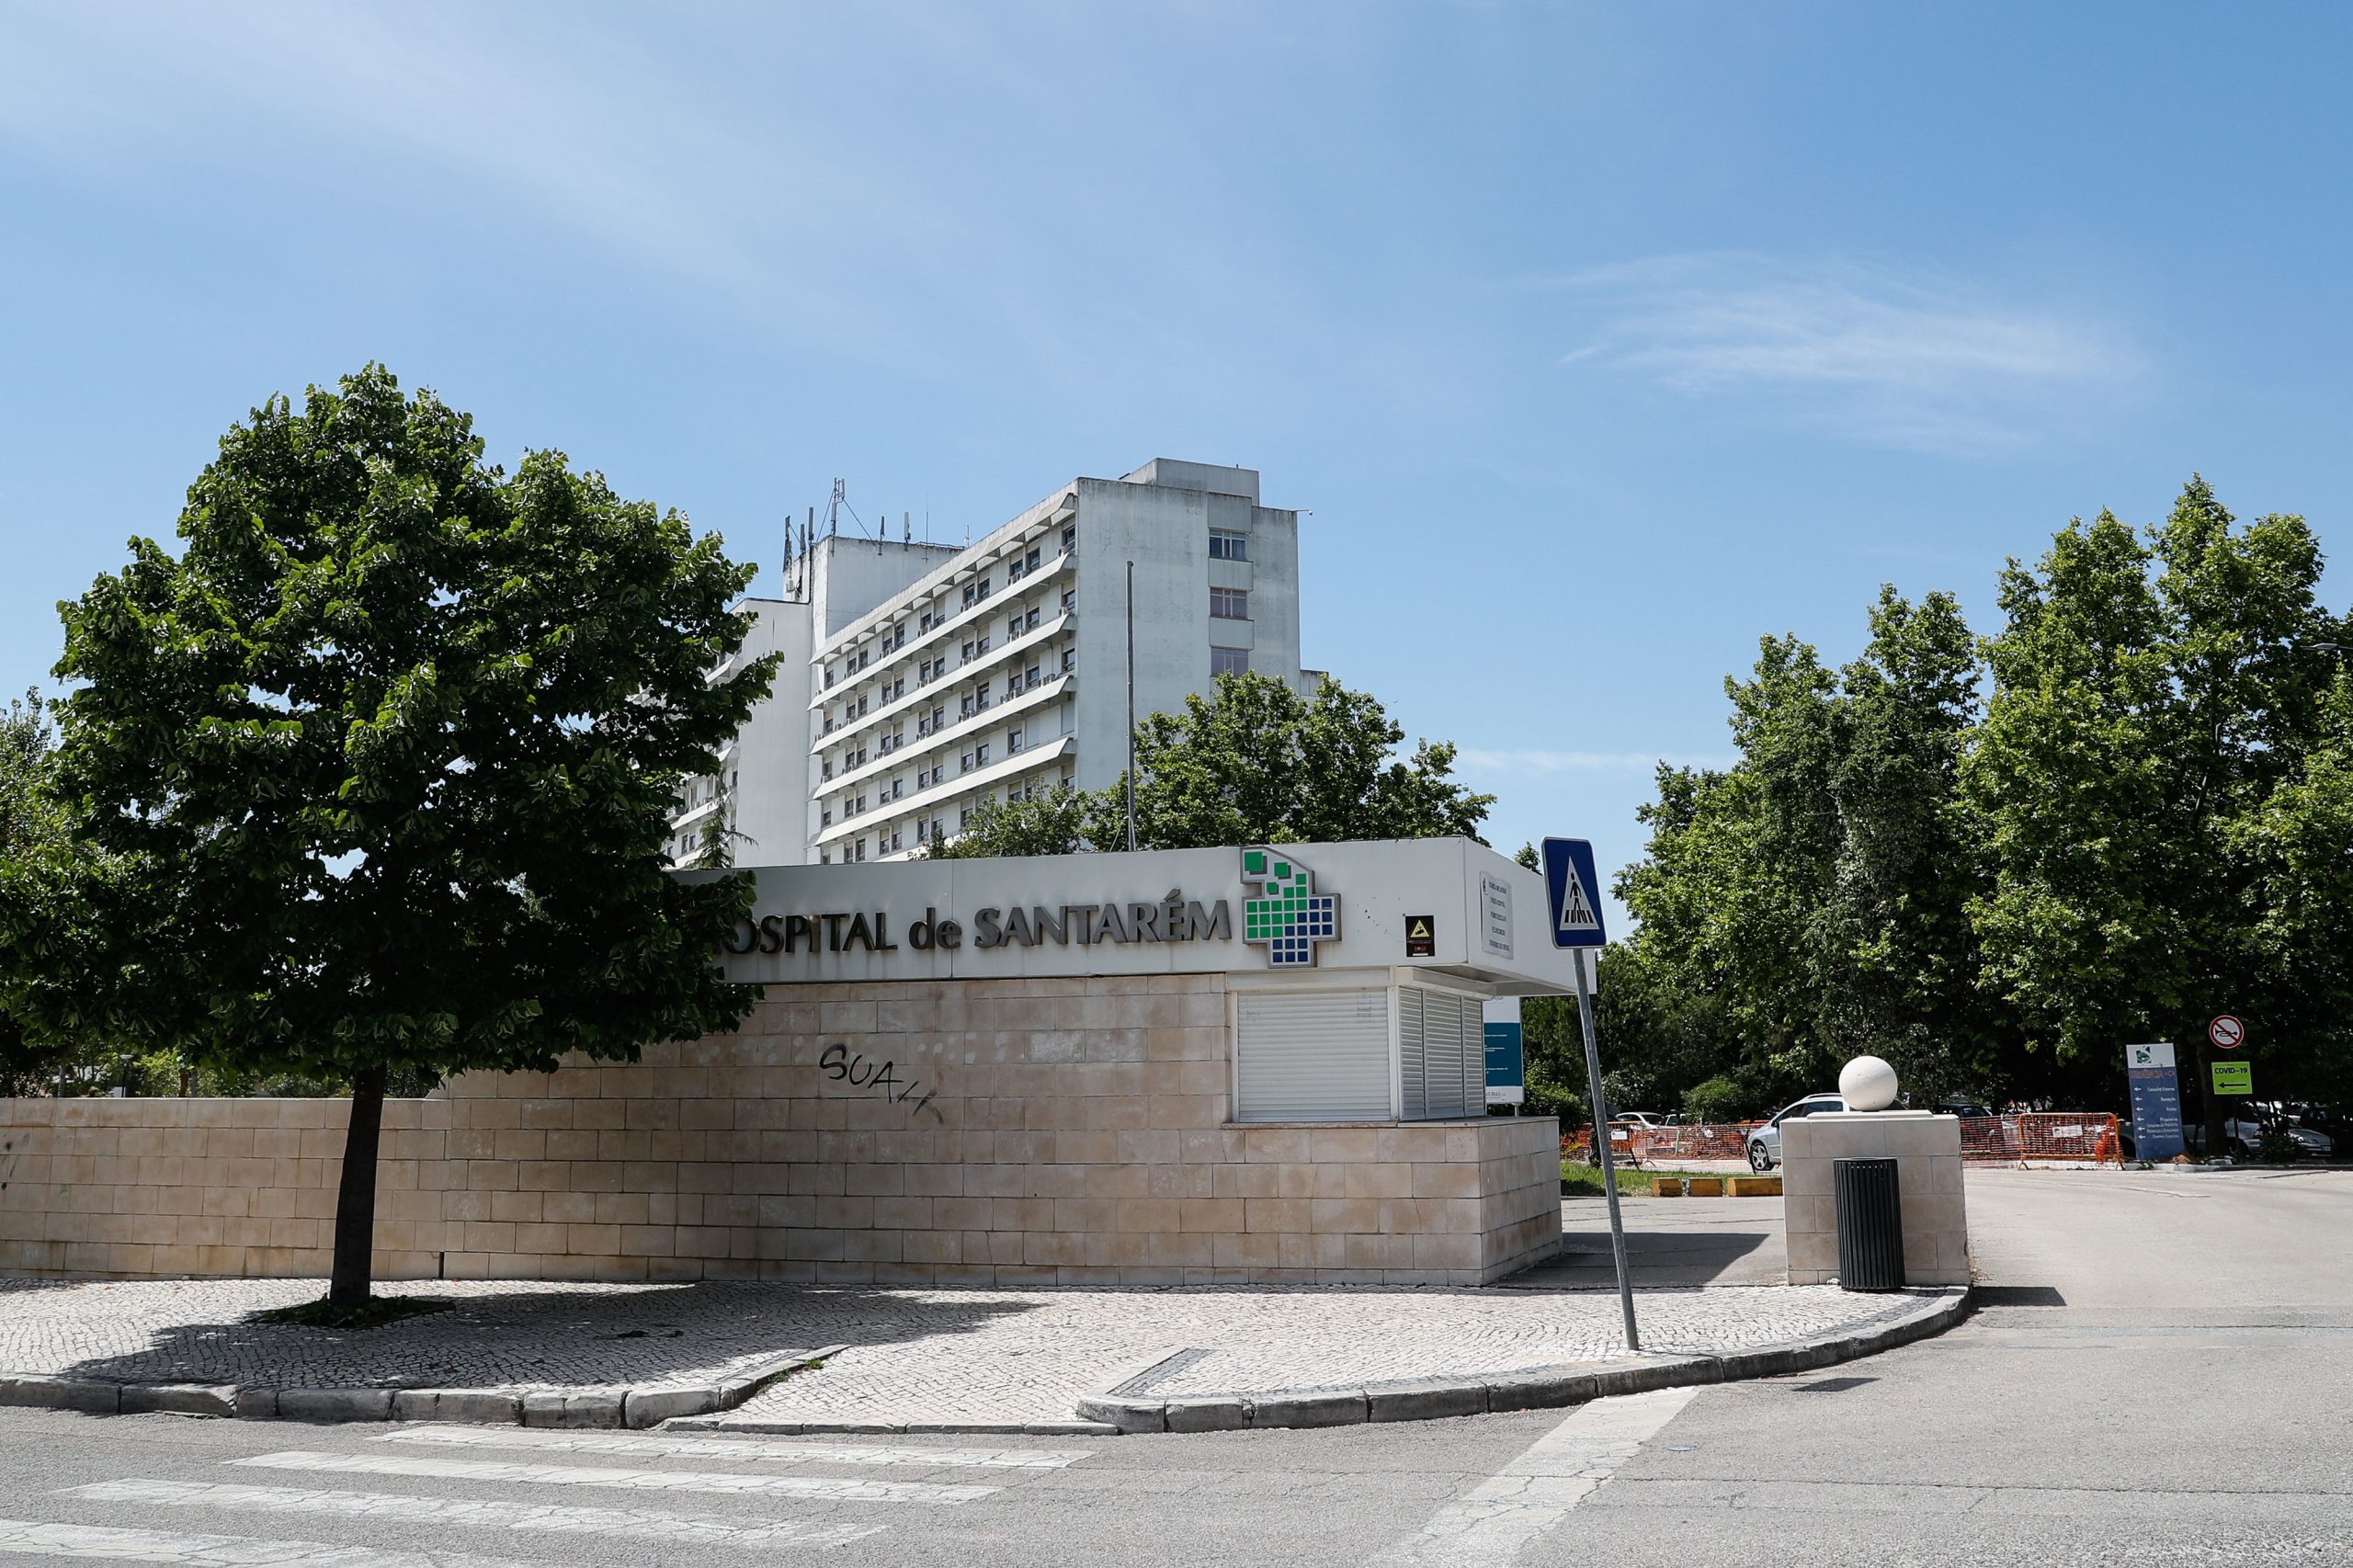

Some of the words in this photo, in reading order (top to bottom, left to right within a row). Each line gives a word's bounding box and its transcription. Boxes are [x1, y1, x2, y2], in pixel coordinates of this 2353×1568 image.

[713, 911, 897, 954] OSPITAL
[909, 906, 962, 950] de
[974, 889, 1232, 949] SANTARÉM
